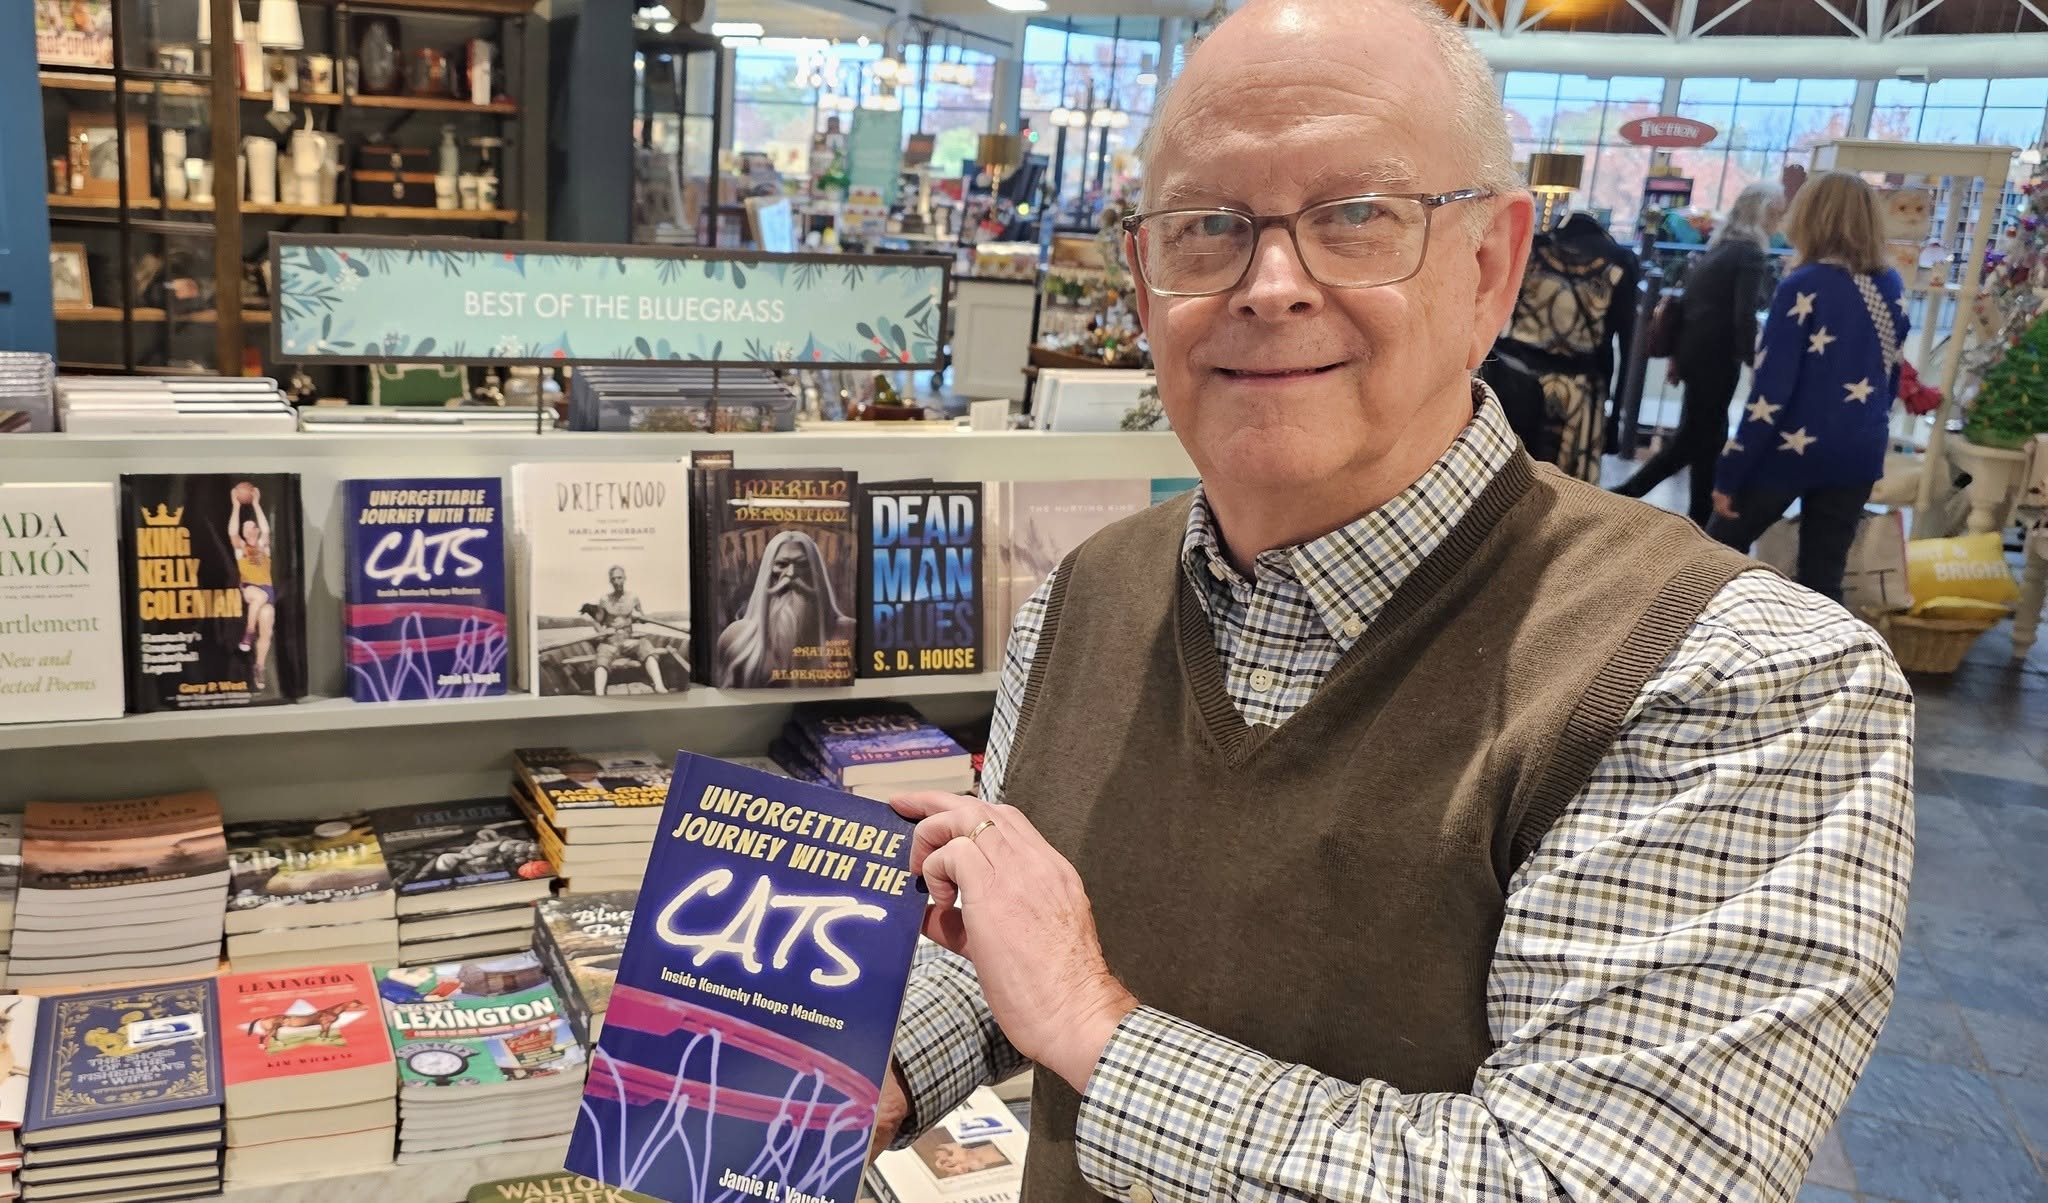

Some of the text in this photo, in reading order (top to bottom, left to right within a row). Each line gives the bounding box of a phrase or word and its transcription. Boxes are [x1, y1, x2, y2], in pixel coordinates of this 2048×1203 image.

[1640, 120, 1698, 139] FICTION
[464, 290, 785, 324] BEST OF THE BLUEGRASS
[369, 489, 486, 507] UNFORGETTABLE
[556, 480, 666, 512] DRIFTWOOD
[743, 479, 848, 499] MERLIN
[359, 507, 495, 525] JOURNEY WITH THE
[735, 506, 848, 522] DEPOSITION
[872, 495, 974, 546] DEAD
[1029, 504, 1049, 513] THE
[0, 512, 68, 539] ADA
[568, 527, 656, 536] HARLAN HUBBARD
[137, 526, 191, 557] KING
[364, 527, 489, 586] CATS
[138, 558, 200, 589] KELLY
[873, 547, 974, 602] MAN
[139, 588, 243, 620] COLEMAN
[873, 600, 974, 649] BLUES
[873, 648, 975, 671] S. D. HOUSE
[46, 676, 97, 694] Poems
[828, 722, 918, 735] QUILT
[850, 747, 950, 761] Silas House
[699, 784, 906, 858] UNFORGETTABLE
[671, 812, 912, 896] JOURNEY WITH THE
[656, 868, 888, 987] CATS
[238, 973, 356, 994] LEXINGTON
[661, 966, 844, 1030] Inside Kentucky Hoops Madness
[392, 996, 555, 1031] LEXINGTON
[87, 1056, 121, 1067] THE
[98, 1056, 166, 1072] OF THE
[267, 1059, 291, 1069] KIM
[111, 1073, 154, 1086] WIFE
[719, 1168, 763, 1197] Jamie
[765, 1180, 780, 1202] H.
